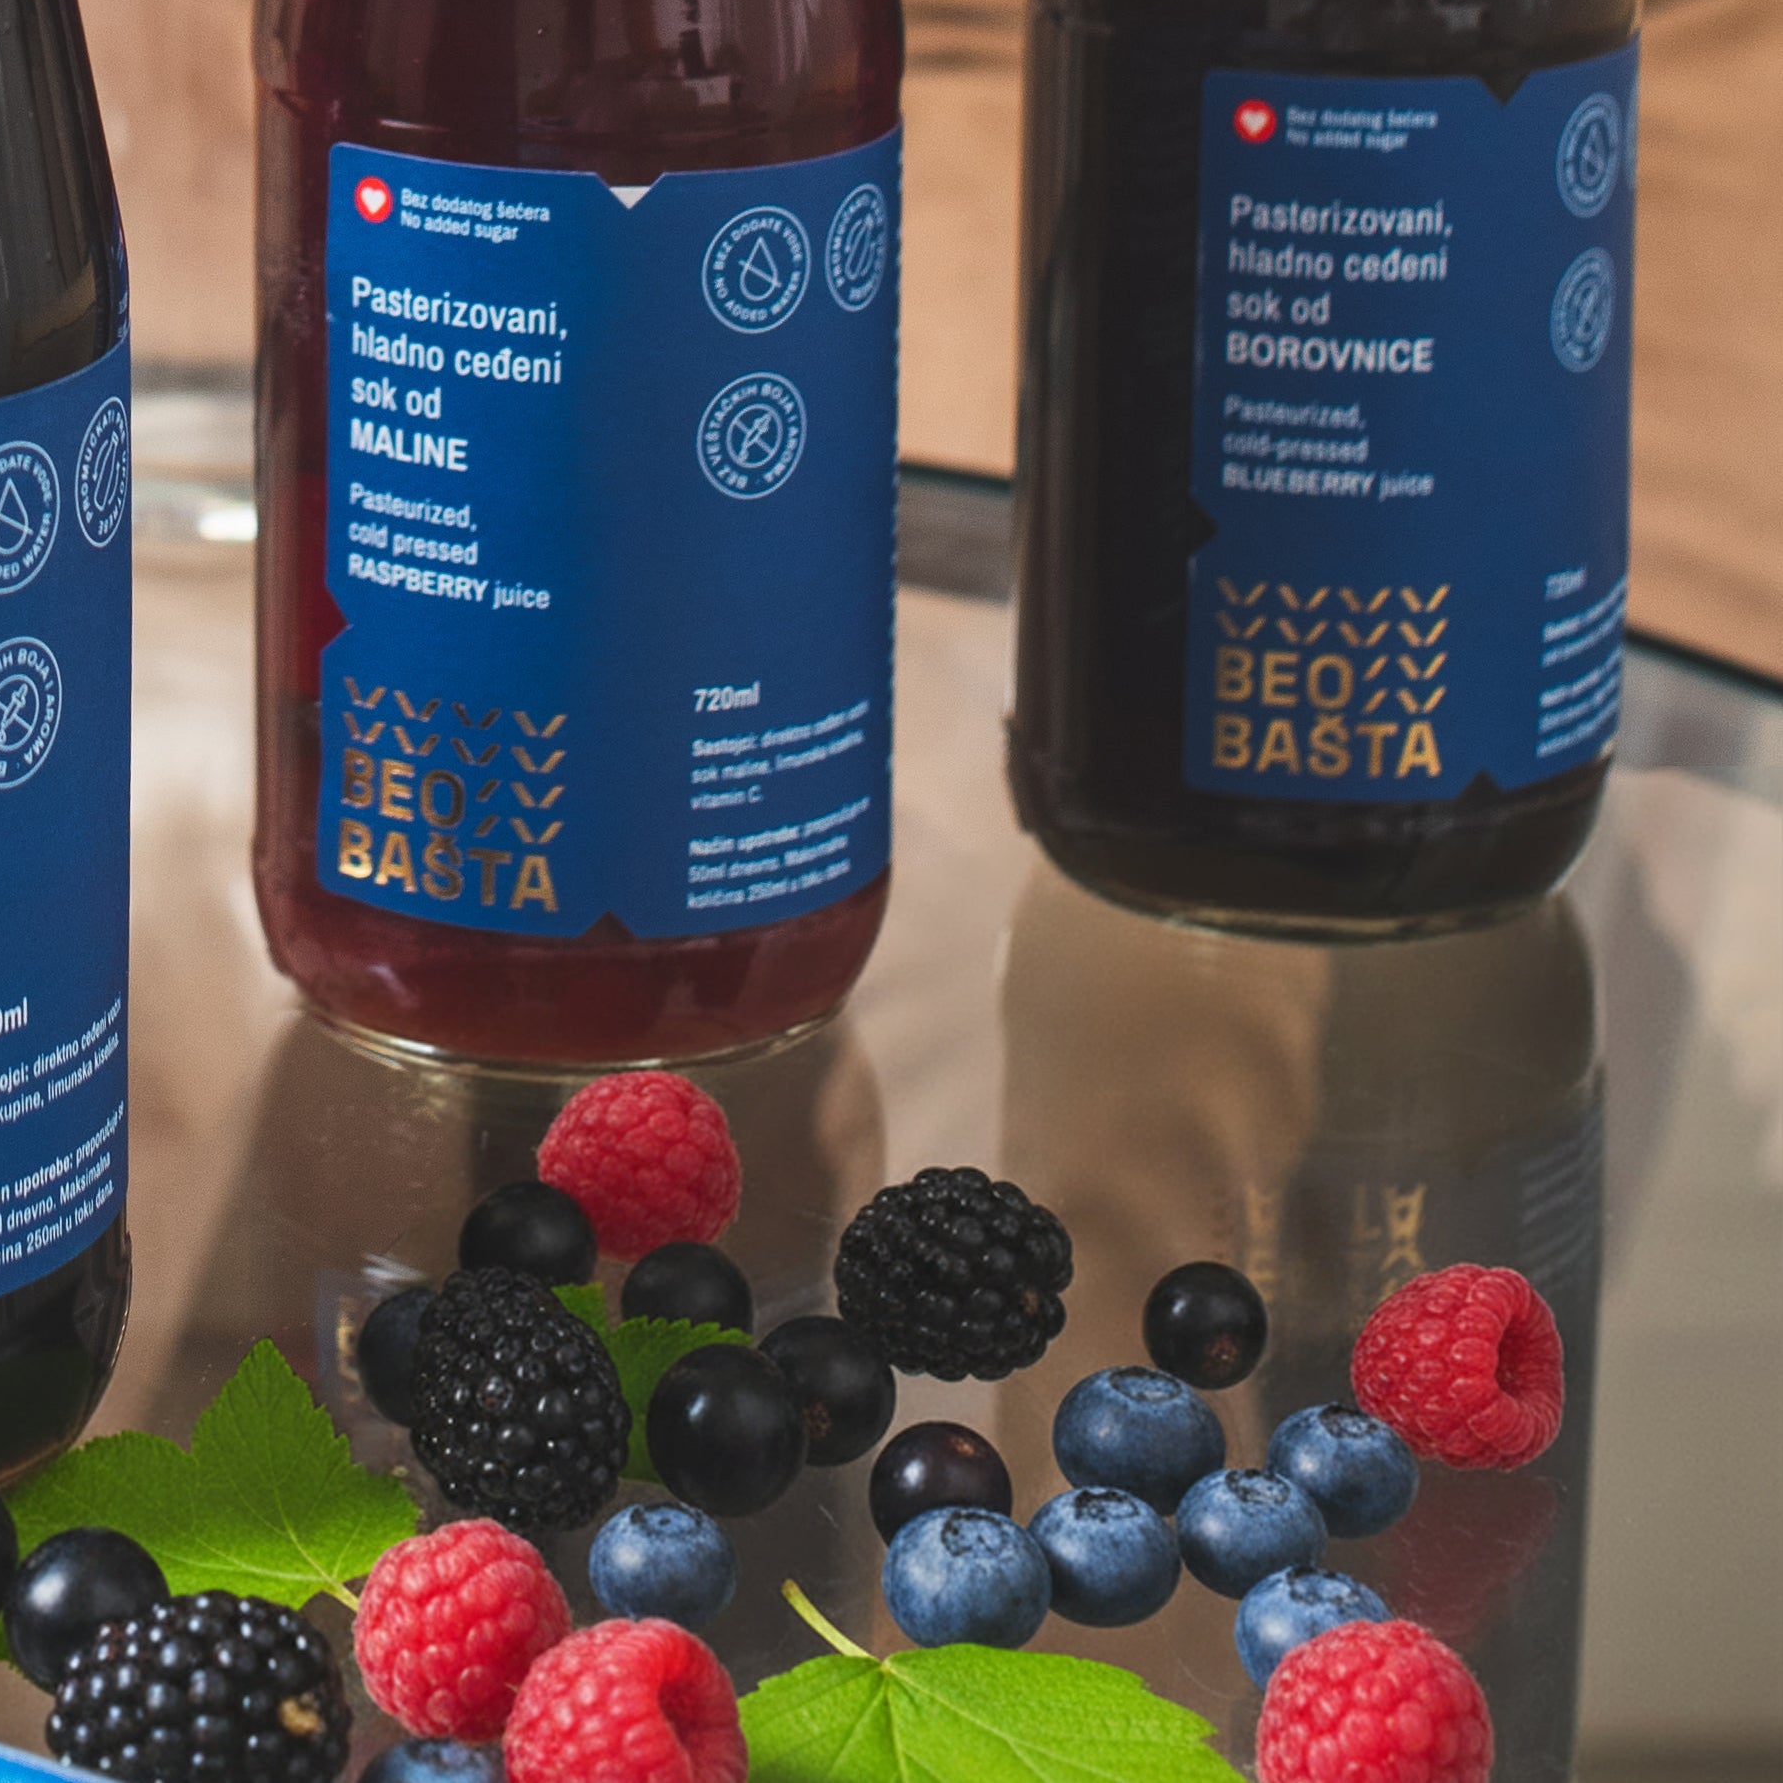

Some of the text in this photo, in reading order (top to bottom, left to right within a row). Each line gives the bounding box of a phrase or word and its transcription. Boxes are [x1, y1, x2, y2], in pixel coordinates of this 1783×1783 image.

[400, 187, 428, 208] Bez
[431, 193, 492, 221] dodatog
[400, 210, 519, 244] No added sugar
[1230, 193, 1453, 239] Pasterizovani,
[1229, 237, 1334, 280] hladno
[352, 275, 568, 341] Pasterizovani,
[1226, 287, 1332, 325] sok od
[352, 322, 562, 385] hladno ceđeni
[1226, 330, 1435, 373] BOROVNICE
[351, 376, 442, 419] sok od
[350, 417, 469, 472] MALINE
[32, 458, 53, 505] VODE
[1221, 461, 1435, 502] BLUEBERRY juice
[349, 481, 478, 533] Pasteurized,
[22, 511, 52, 568] WATER
[348, 521, 479, 566] cold pressed
[348, 551, 551, 611] RASPBERRY juice
[17, 647, 52, 683] BOJA
[44, 679, 54, 690] I
[1217, 646, 1355, 709] BEO
[692, 679, 761, 713] 720ml
[23, 693, 56, 765] AROMA
[1213, 712, 1442, 779] BAŠTA
[340, 746, 466, 830] BEO
[338, 817, 559, 914] BAŠTA
[33, 1037, 80, 1079] direktno
[48, 1060, 94, 1103] limunska
[7, 1194, 57, 1233] dnevno.
[59, 1150, 111, 1206] Maksimalna
[14, 1150, 74, 1199] upotrebe:
[26, 1221, 64, 1255] 250ml
[65, 1214, 73, 1233] u
[74, 1199, 94, 1228] toku
